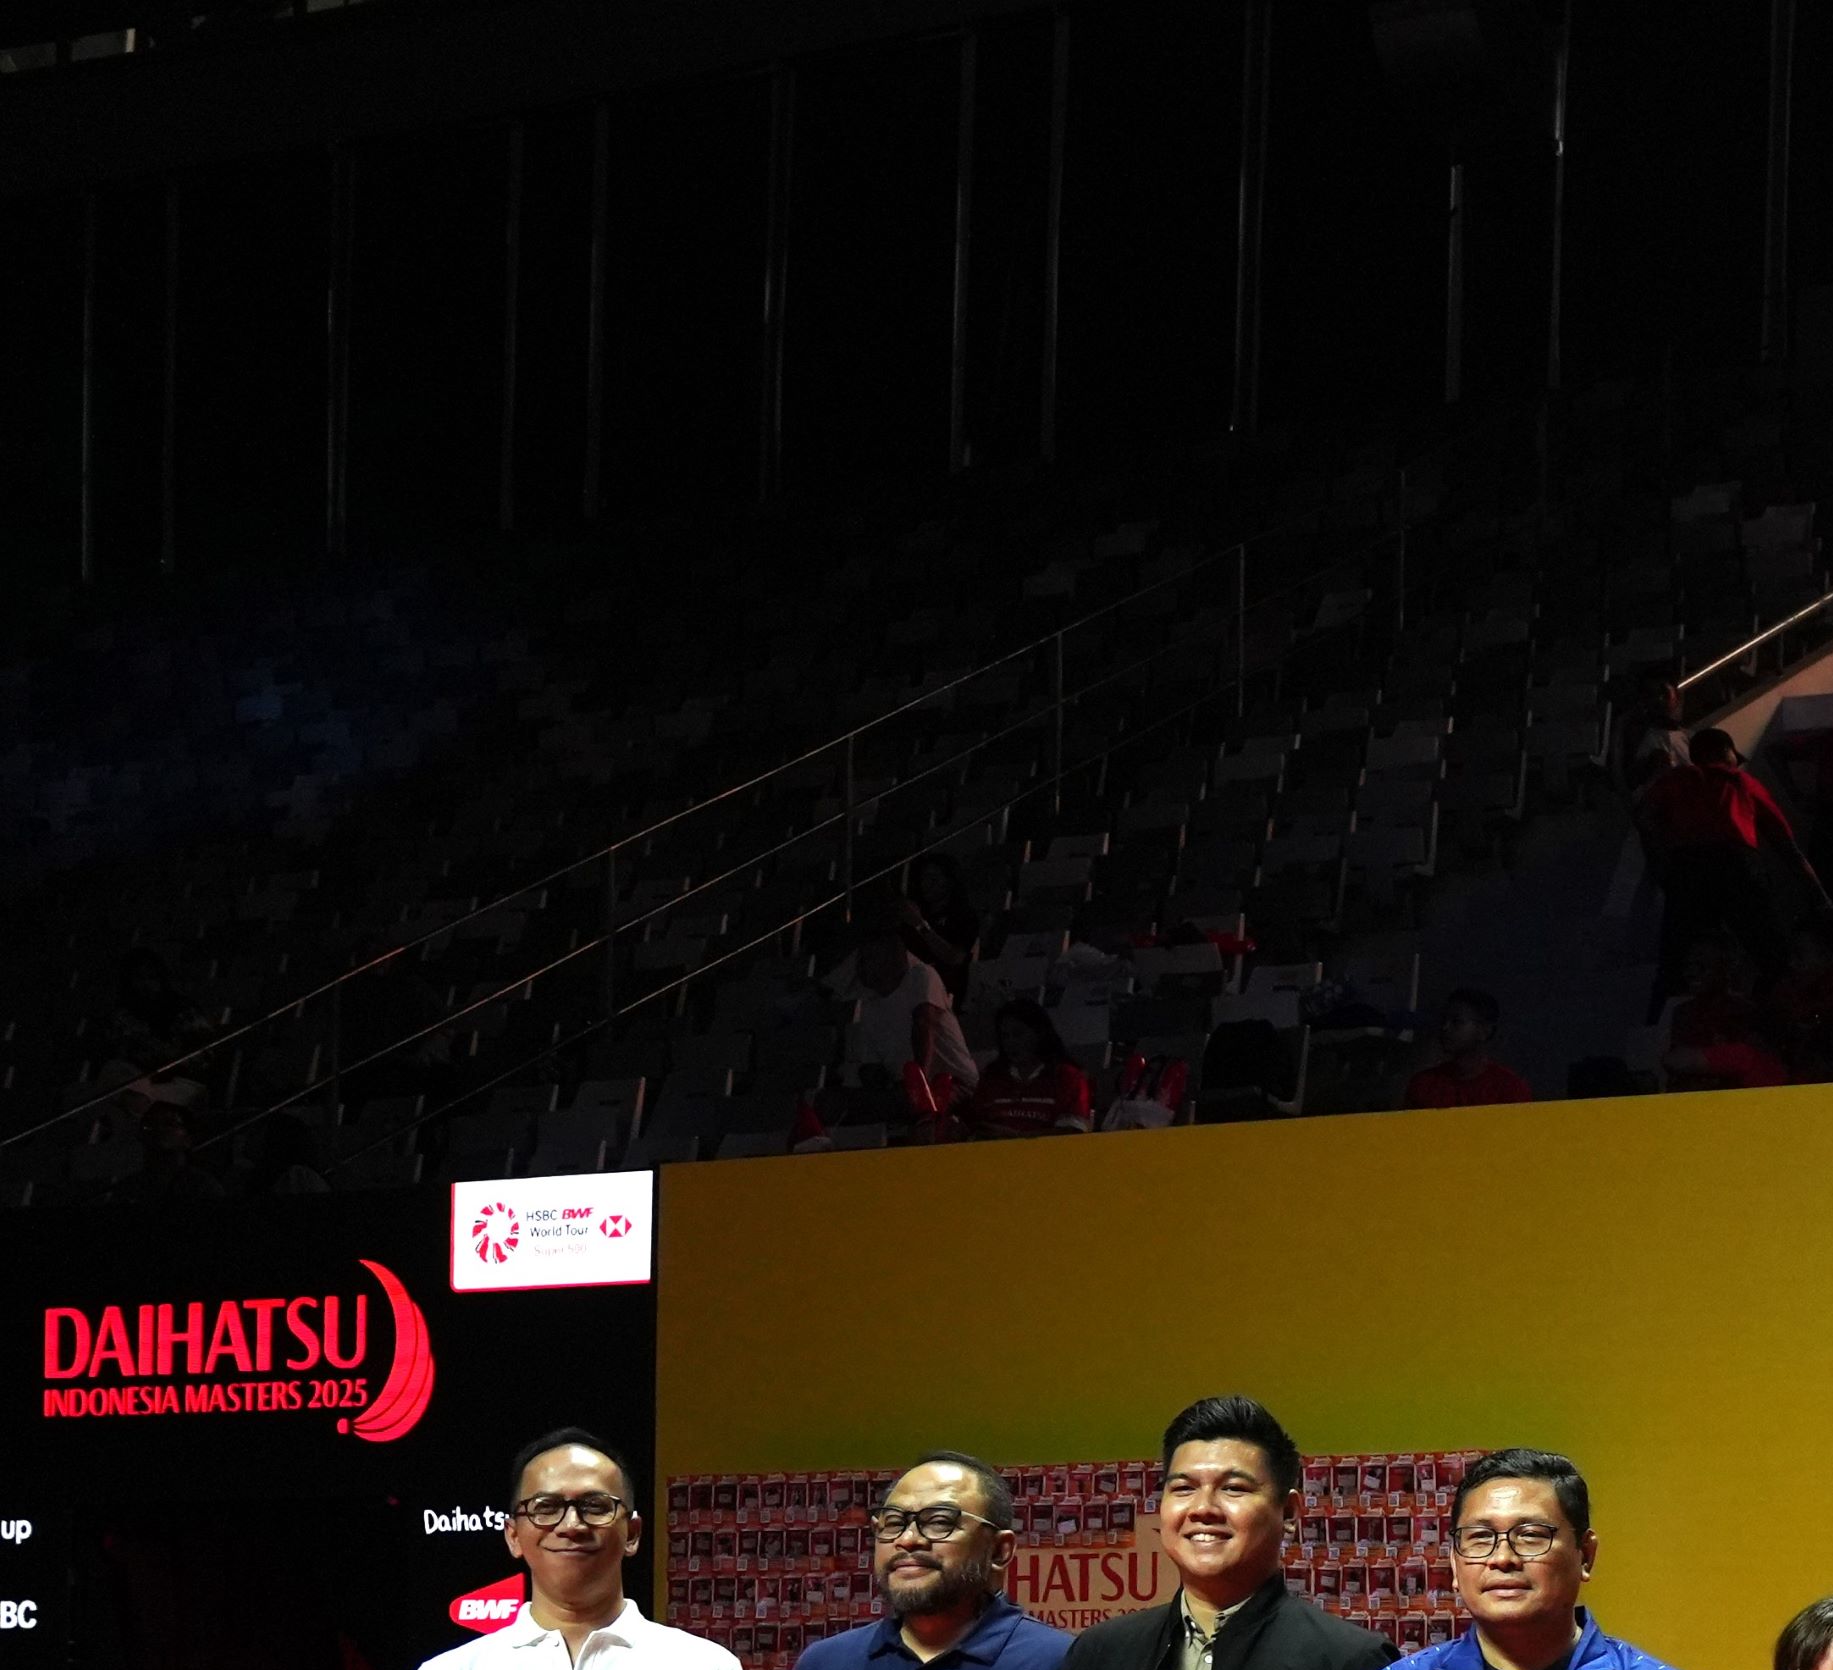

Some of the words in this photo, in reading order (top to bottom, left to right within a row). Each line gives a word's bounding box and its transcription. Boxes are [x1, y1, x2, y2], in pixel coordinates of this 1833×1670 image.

[526, 1209, 558, 1221] HSBC
[562, 1206, 594, 1219] BWF
[530, 1225, 562, 1238] World
[566, 1223, 589, 1236] Tour
[44, 1294, 367, 1379] DAIHATSU
[44, 1385, 180, 1417] INDONESIA
[185, 1380, 301, 1413] MASTERS
[308, 1379, 368, 1409] 2025
[424, 1506, 510, 1535] Daihats
[458, 1599, 519, 1620] BWF
